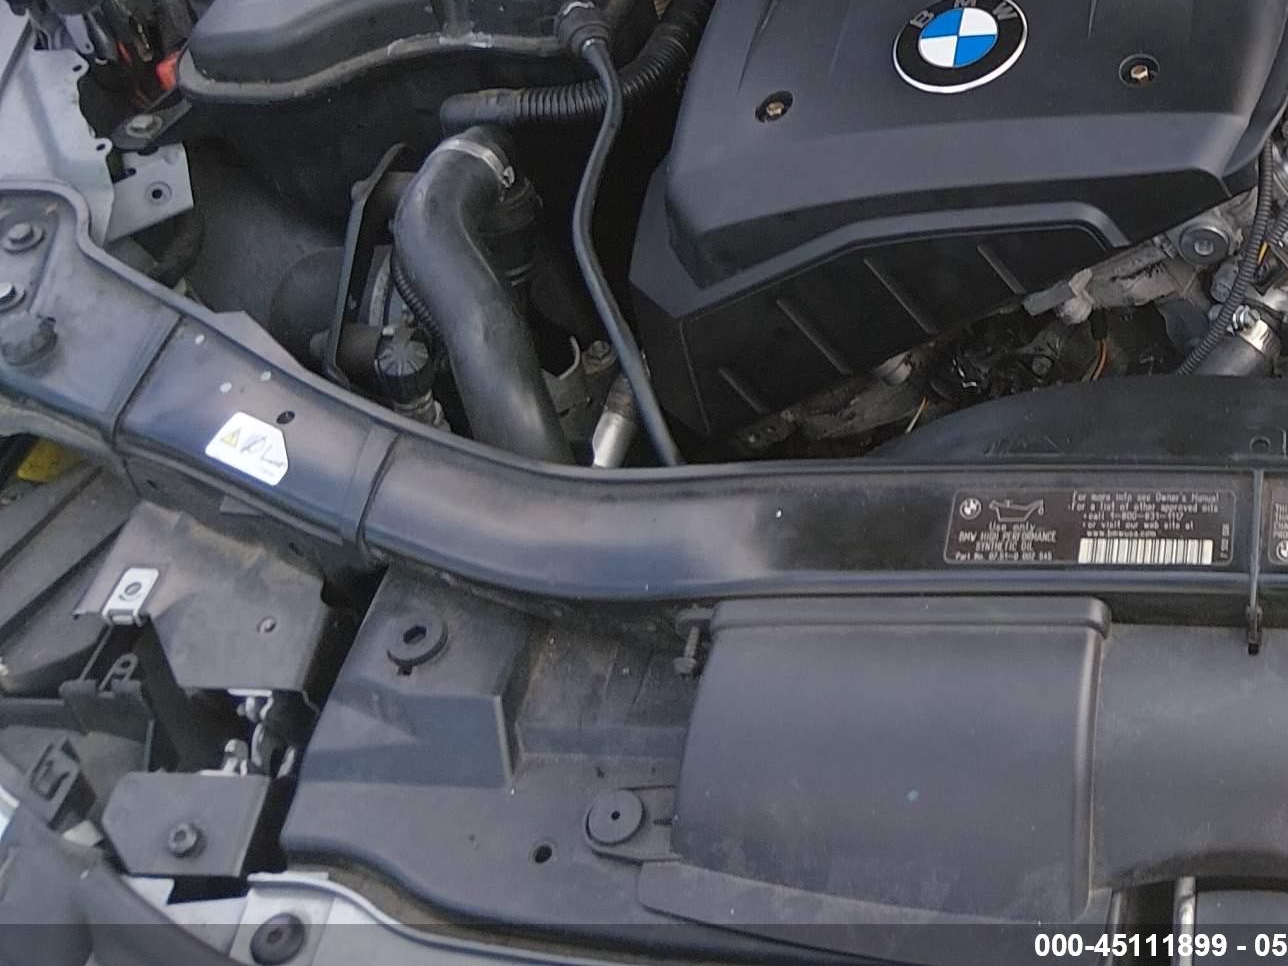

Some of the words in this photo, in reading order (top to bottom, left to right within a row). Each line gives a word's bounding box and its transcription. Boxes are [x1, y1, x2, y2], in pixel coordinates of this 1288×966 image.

[988, 521, 1007, 531] Use
[1012, 521, 1036, 532] only
[958, 531, 977, 542] BMW
[980, 531, 1000, 542] HIGH
[1002, 530, 1057, 543] PERFORMANCE
